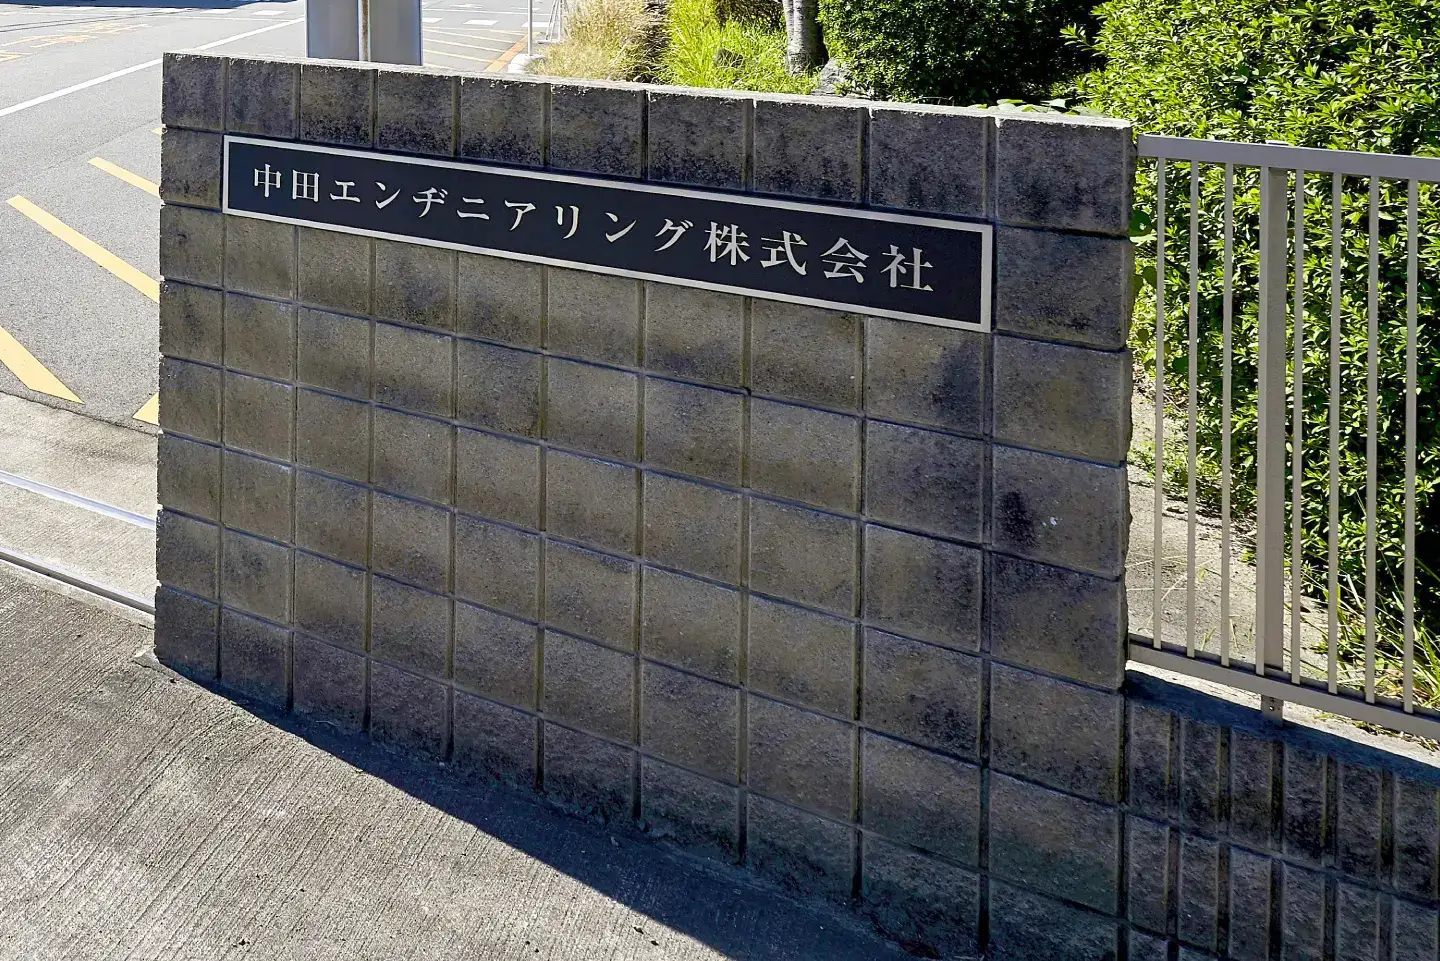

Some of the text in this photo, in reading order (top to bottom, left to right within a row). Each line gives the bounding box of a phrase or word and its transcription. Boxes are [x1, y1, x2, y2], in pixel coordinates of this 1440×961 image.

[252, 163, 935, 293] 中田エンヂニアリング株式会社
